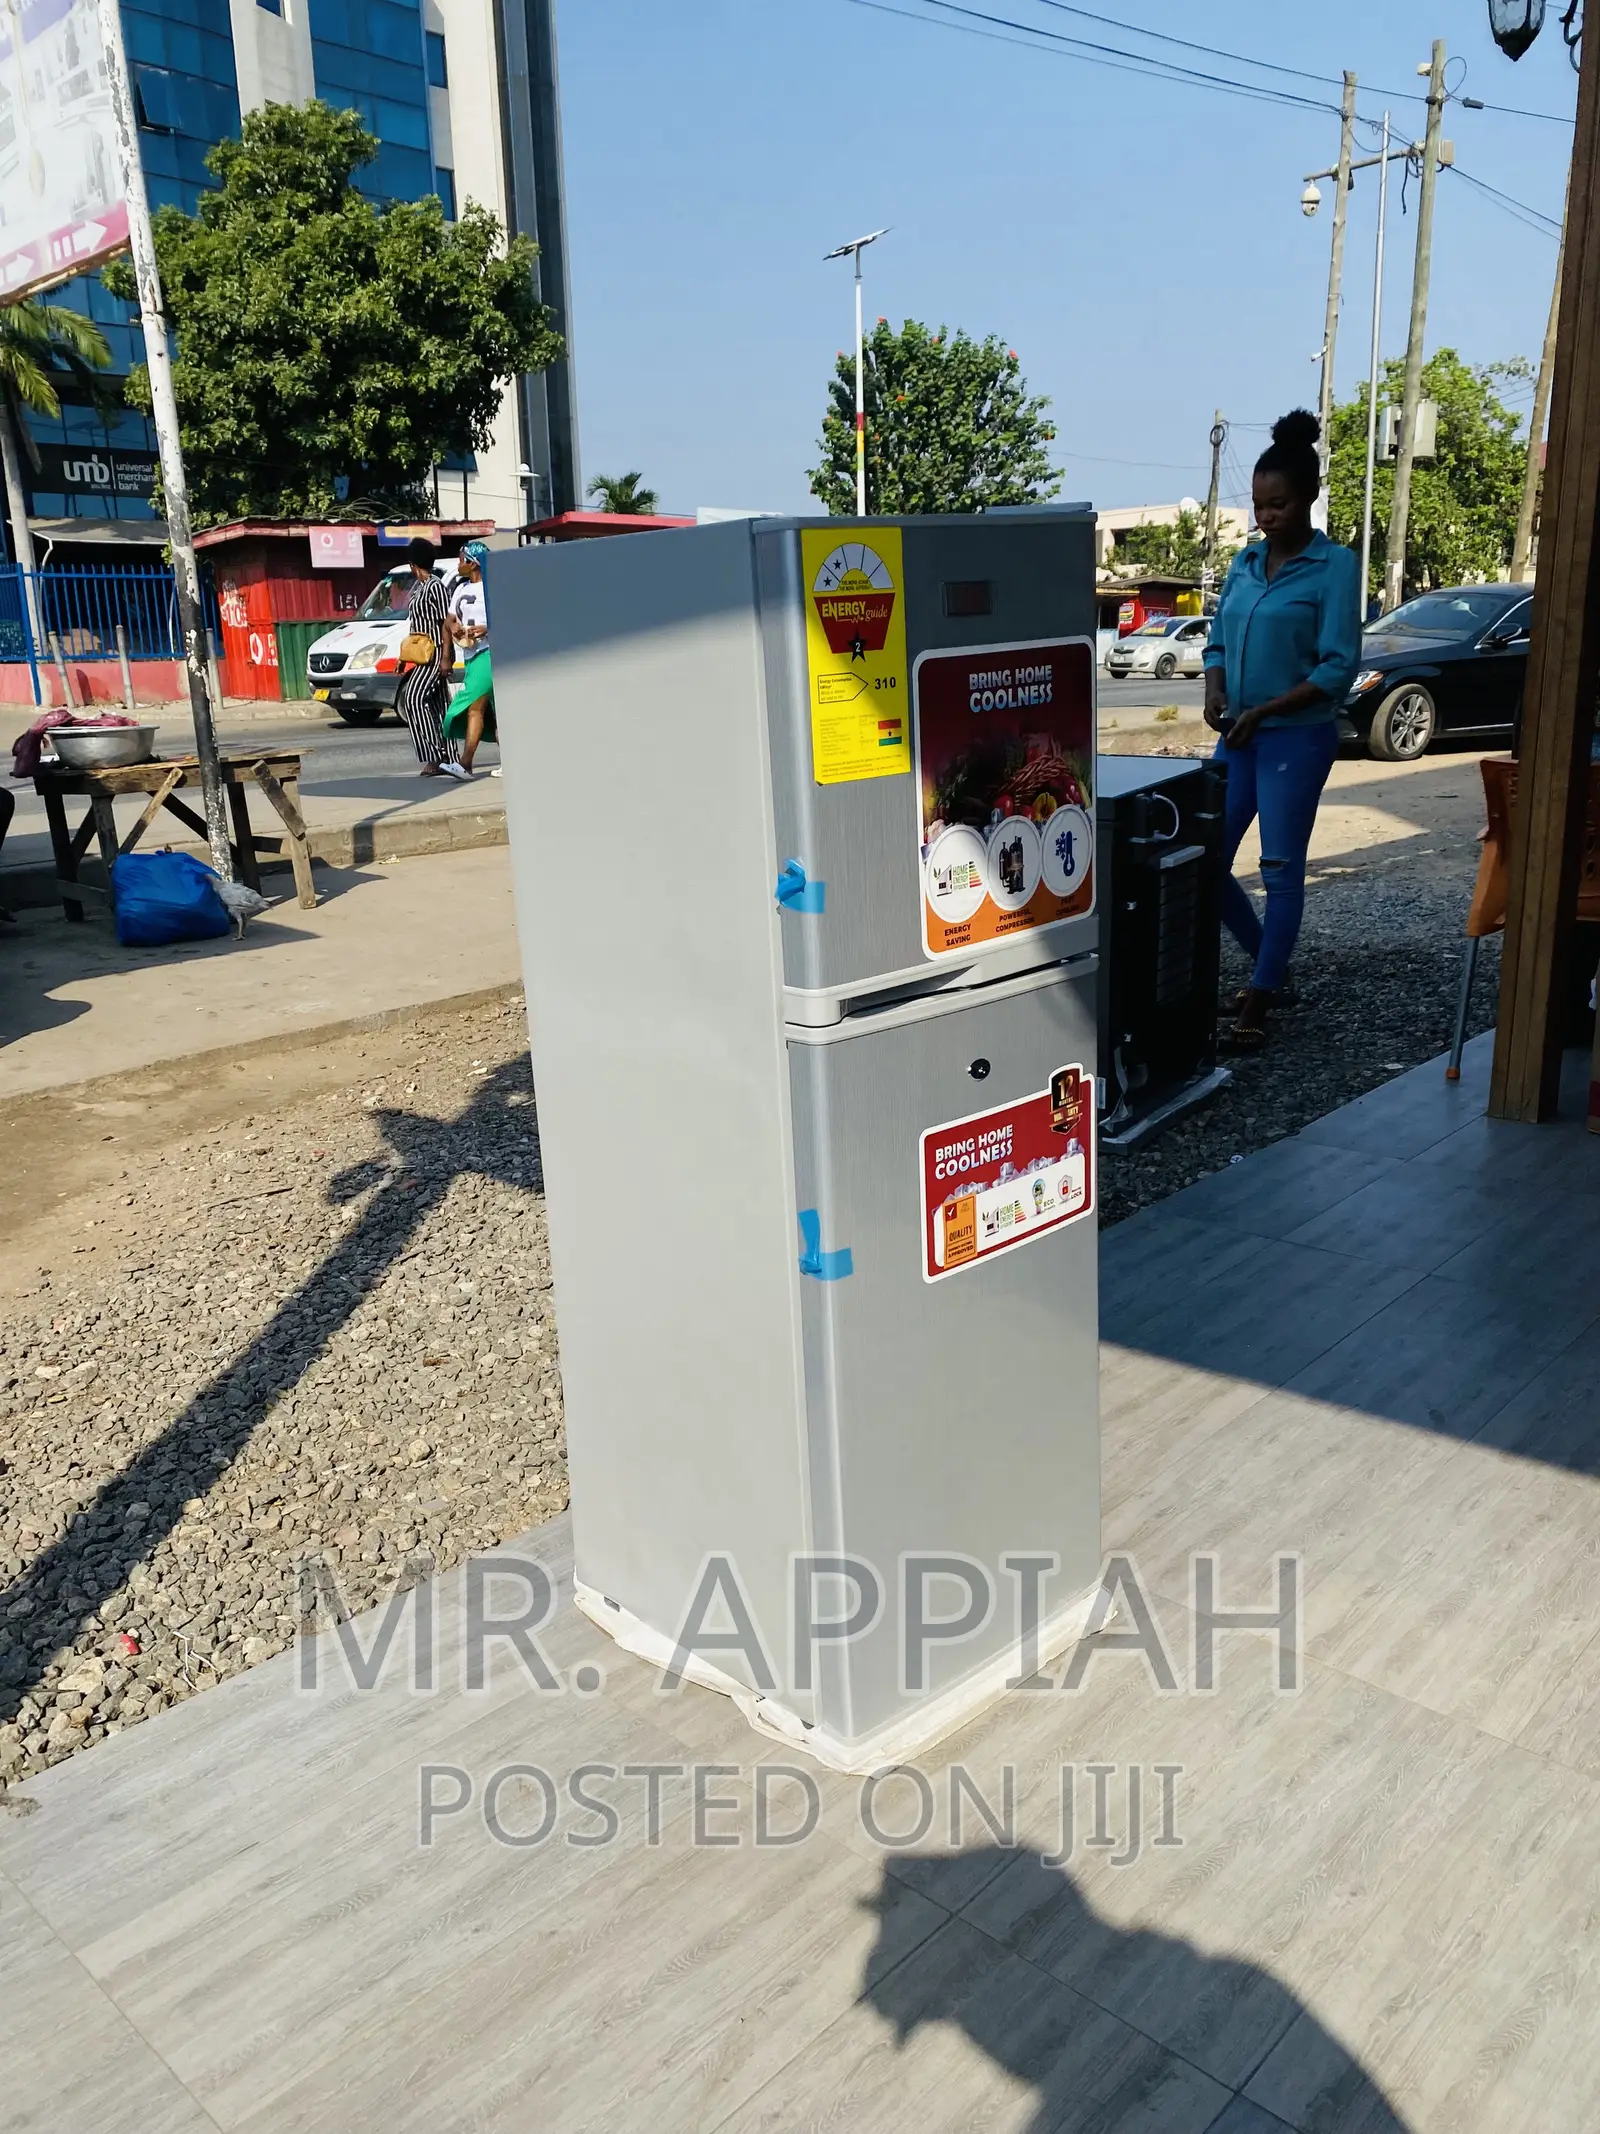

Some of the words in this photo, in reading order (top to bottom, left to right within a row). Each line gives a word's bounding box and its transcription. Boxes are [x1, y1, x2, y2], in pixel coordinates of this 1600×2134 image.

[63, 454, 110, 483] umb
[116, 462, 153, 472] universal
[118, 481, 139, 491] bank
[822, 599, 866, 621] ENERGY
[865, 604, 888, 621] guide
[855, 642, 861, 652] 2
[874, 677, 897, 690] 310
[969, 669, 1012, 690] BRING
[1015, 665, 1052, 685] HOME
[969, 683, 1053, 713] COOLNESS
[999, 908, 1032, 922] POWERFUL
[944, 923, 971, 937] ENERGY
[995, 917, 1035, 933] COMPRESSOR
[946, 934, 971, 947] SAVING
[1058, 1075, 1074, 1100] 12
[935, 1138, 975, 1162] BRING
[978, 1124, 1014, 1148] HOME
[935, 1139, 1013, 1179] COOLNESS
[1043, 1198, 1055, 1207] ECO
[949, 1224, 973, 1241] QUALITY
[947, 1244, 974, 1259] APPROVED
